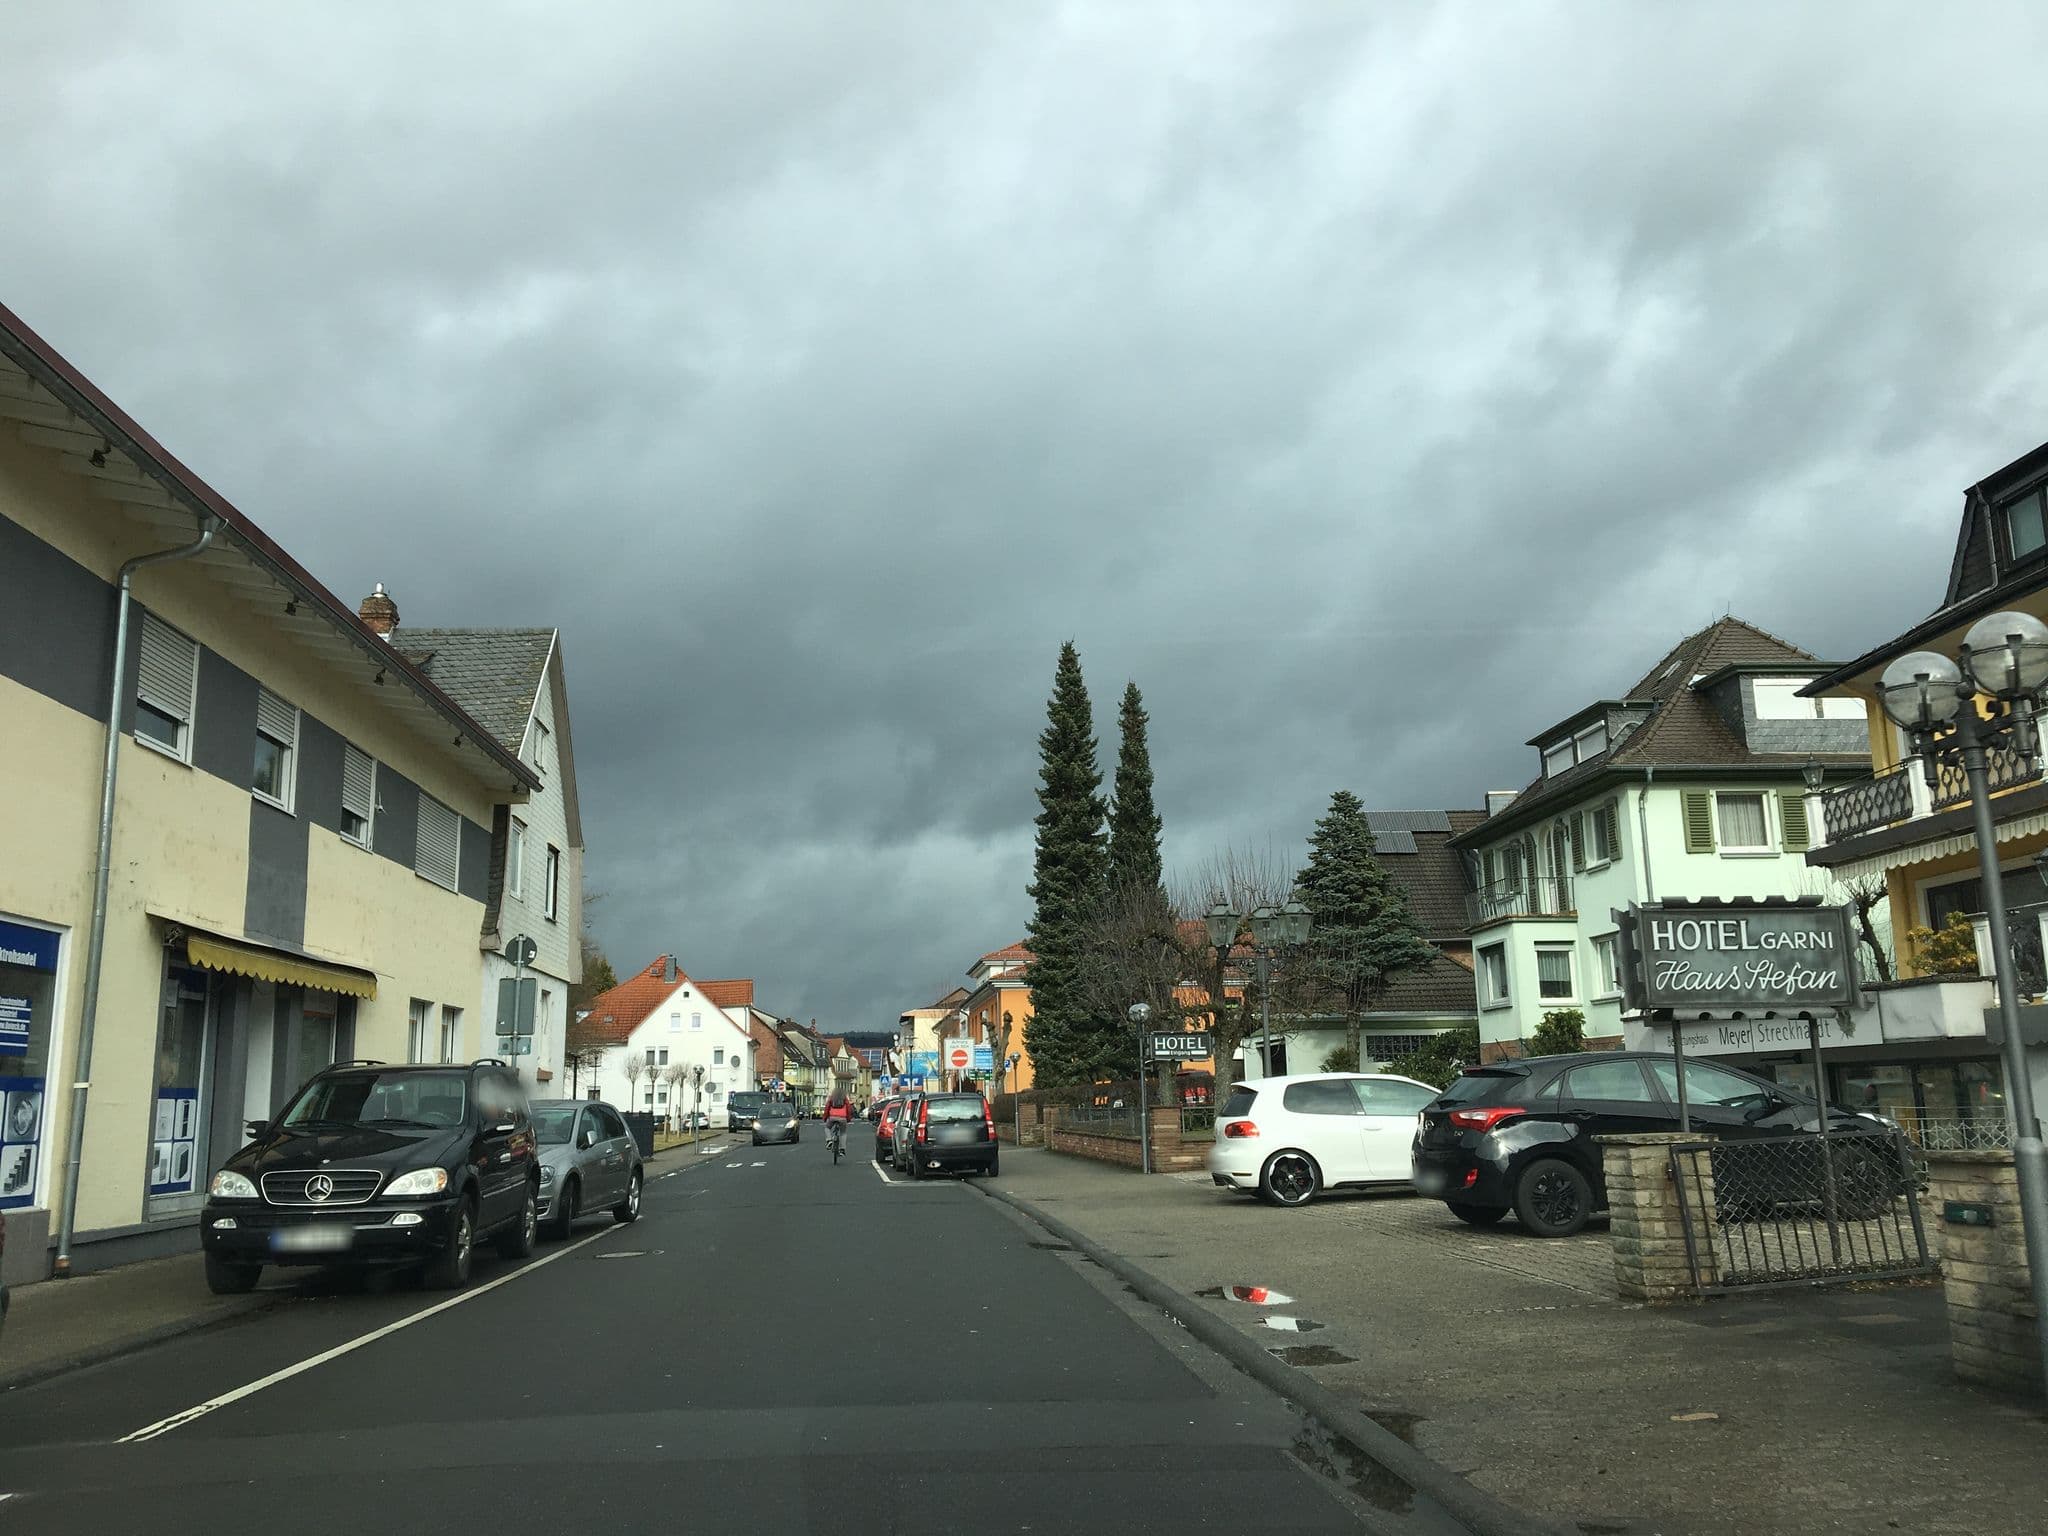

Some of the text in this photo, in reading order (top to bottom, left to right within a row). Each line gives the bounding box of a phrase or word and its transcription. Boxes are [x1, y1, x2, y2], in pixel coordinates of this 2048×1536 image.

[1651, 920, 1834, 950] HOTEL GARNI
[1655, 959, 1838, 995] Haus Stefan
[1154, 1037, 1206, 1049] HOTEL
[1719, 1027, 1751, 1048] Meyer
[1758, 1018, 1831, 1043] Streckhadt
